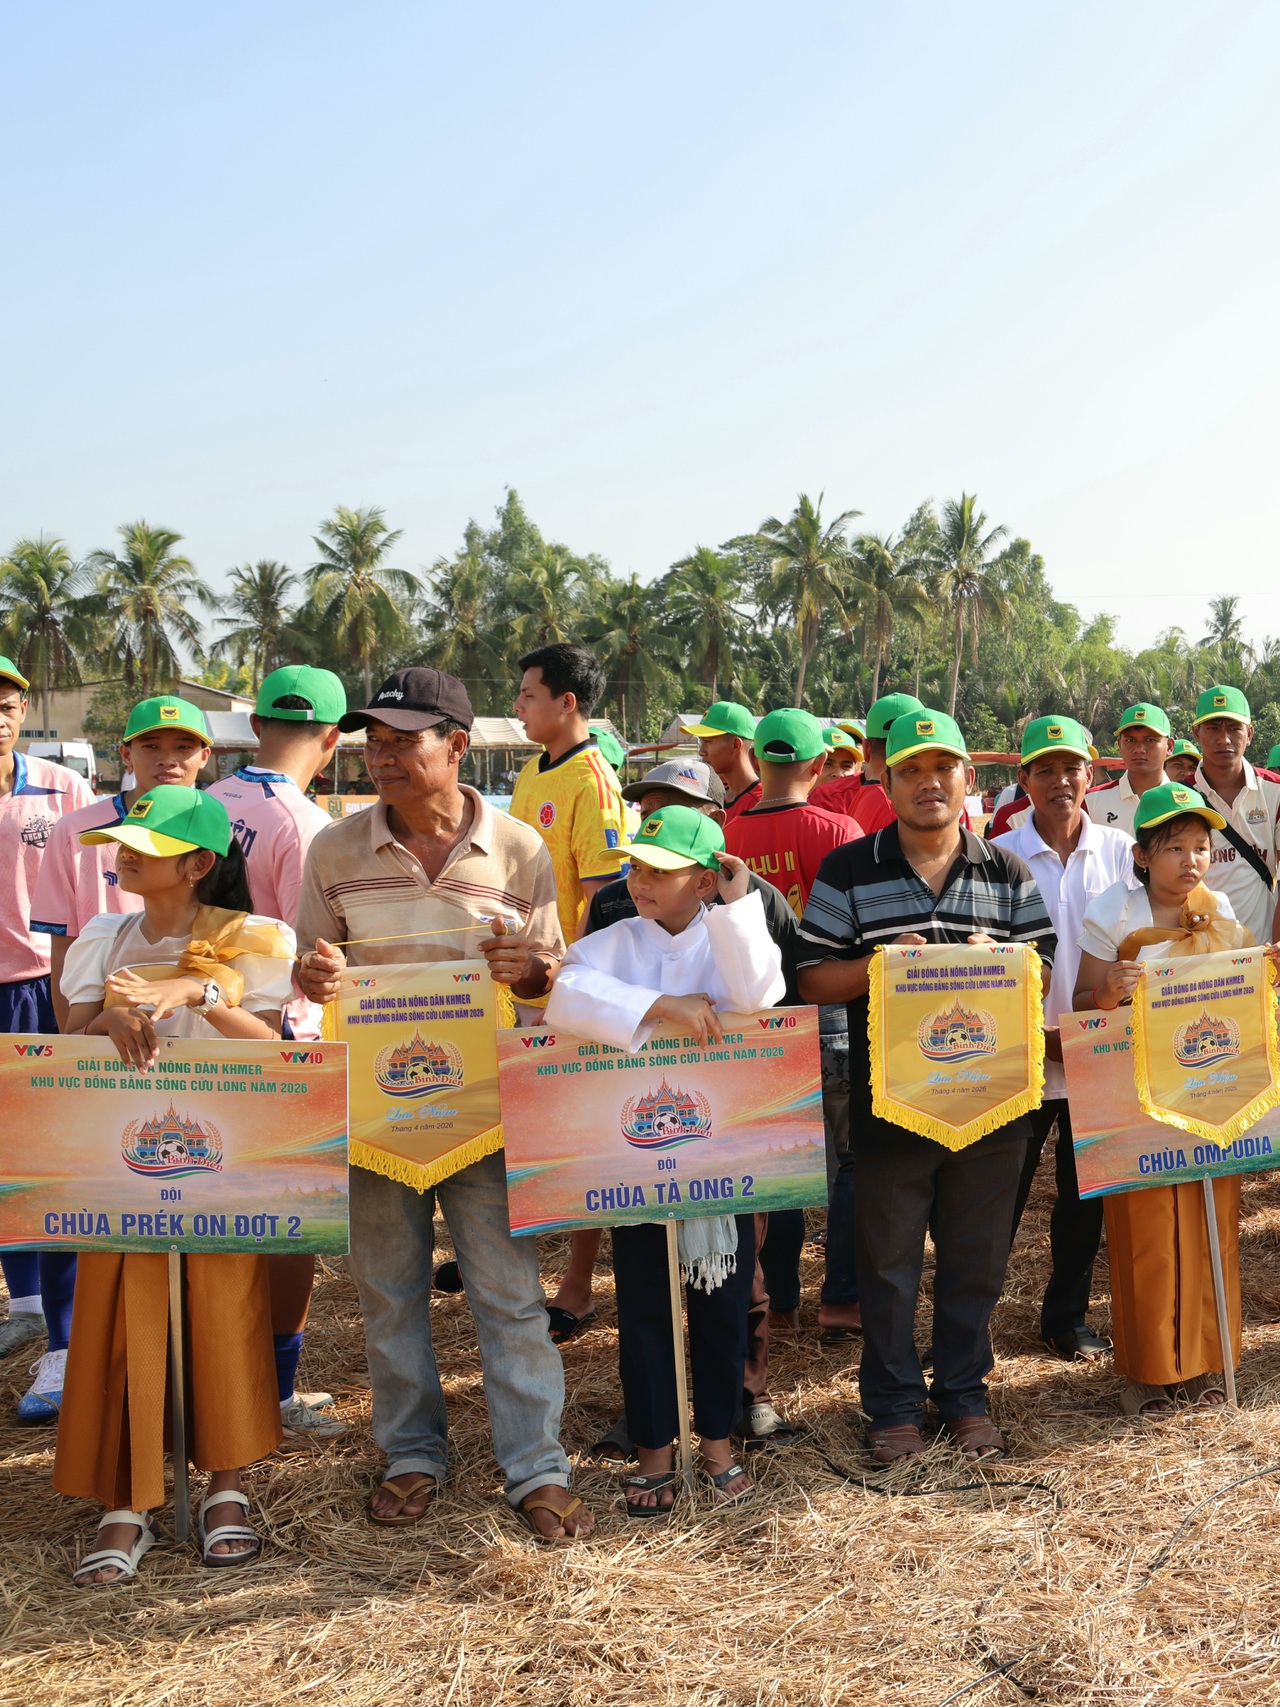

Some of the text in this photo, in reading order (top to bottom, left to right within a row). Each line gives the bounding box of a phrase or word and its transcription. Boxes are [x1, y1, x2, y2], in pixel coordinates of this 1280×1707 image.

[345, 802, 375, 813] GOLD
[1232, 957, 1252, 965] VTV10
[453, 974, 480, 982] VTV10
[907, 965, 1005, 979] GIẢI BÓNG ĐÁ NÔNG DÂN KHMER
[1155, 969, 1174, 977] VTV5
[352, 979, 376, 987] VTV5
[895, 984, 906, 992] KHU
[977, 980, 990, 989] LONG
[360, 994, 471, 1010] GIẢI BÓNG ĐÁ NÔNG DÂN KHMER
[348, 1016, 359, 1024] KHU
[361, 1015, 372, 1025] VỰC
[409, 1010, 424, 1021] SÔNG
[439, 1010, 454, 1019] LONG
[455, 1008, 469, 1018] NĂM
[470, 1009, 484, 1017] 2026
[758, 1017, 797, 1029] VTV10
[1079, 1018, 1107, 1030] VTV5
[521, 1035, 556, 1048] VTV5
[578, 1042, 599, 1056] GIẢI
[652, 1038, 680, 1050] NÔNG
[1094, 1041, 1129, 1054] KHU VỰC
[14, 1045, 53, 1057] VTV5
[280, 1052, 323, 1064] VTV10
[537, 1047, 784, 1076] KHU VỰC ĐỒNG BẰNG SÔNG CỬU LONG NĂM 2026
[77, 1057, 100, 1071] GIẢI
[159, 1060, 190, 1074] NÔNG
[195, 1061, 218, 1074] DÂN
[222, 1064, 262, 1075] KHMER
[31, 1074, 308, 1094] KHU VỰC ĐỒNG BẰNG SÔNG CỬU LONG NĂM 2026
[658, 1157, 677, 1172] ĐỘI
[1138, 1146, 1187, 1174] CHÙA
[160, 1187, 182, 1203] ĐỘI
[585, 1175, 755, 1212] CHÙA TÀ ONG 2
[44, 1208, 301, 1243] CHÙA PRÉK ON ĐỢT 2
